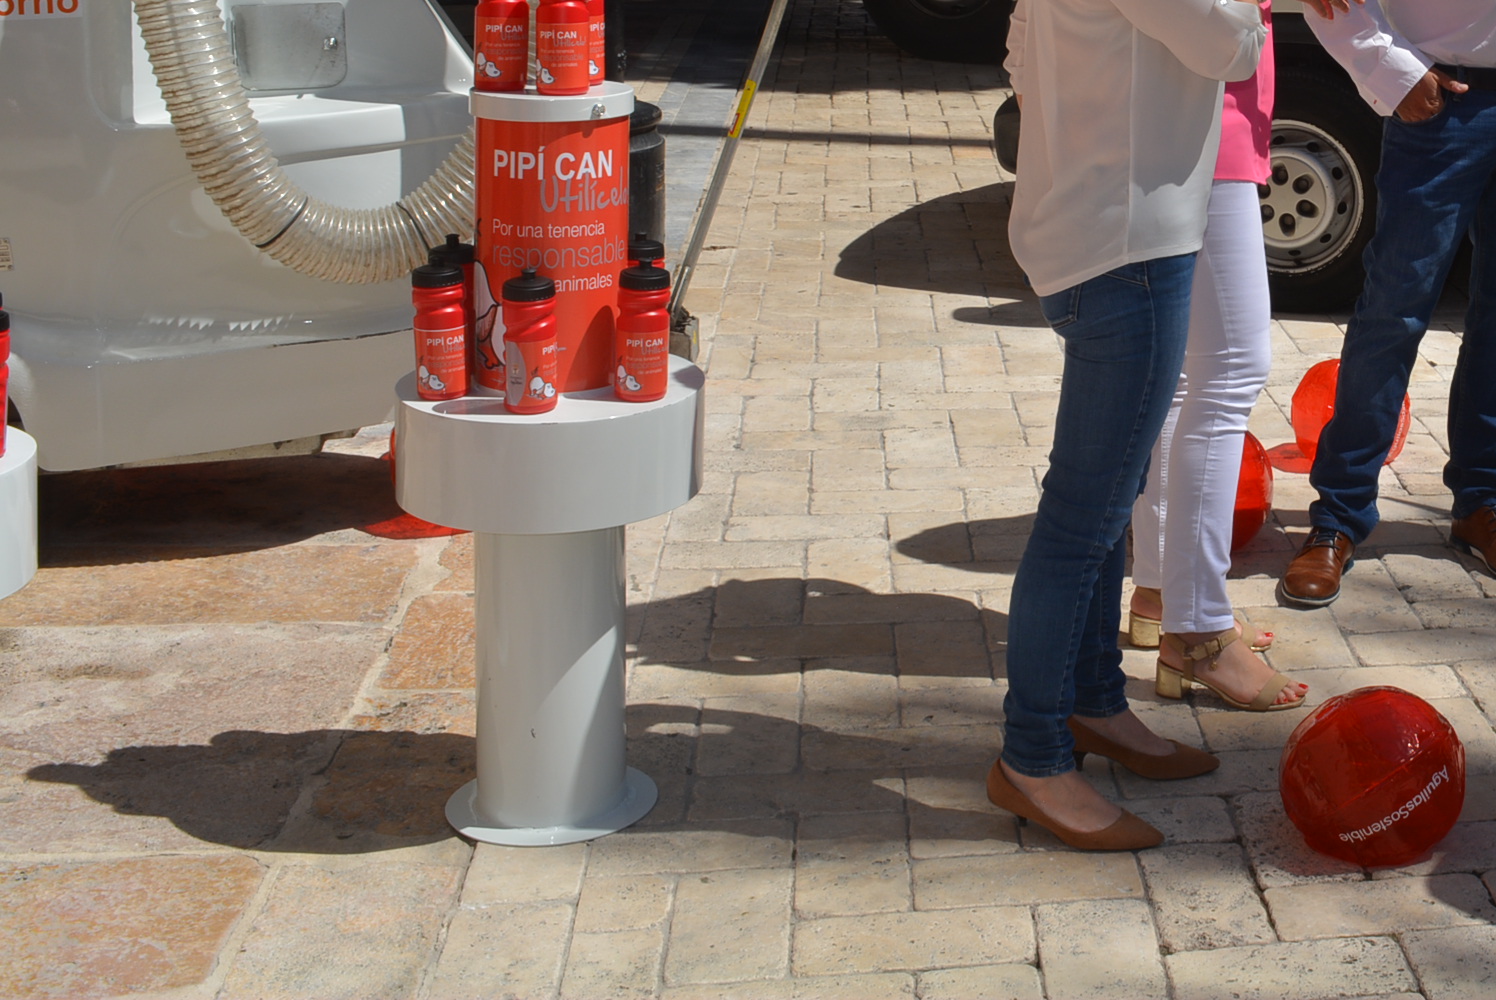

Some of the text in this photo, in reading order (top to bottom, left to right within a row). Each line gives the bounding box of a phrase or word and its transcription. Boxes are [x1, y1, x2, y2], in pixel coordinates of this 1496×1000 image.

[505, 24, 523, 33] CAN
[557, 30, 577, 40] CAN
[493, 146, 613, 181] PIPÍ CAN
[493, 218, 605, 238] Por una tenencia
[493, 235, 625, 269] responsable
[554, 272, 613, 293] animales
[645, 337, 663, 347] CAN
